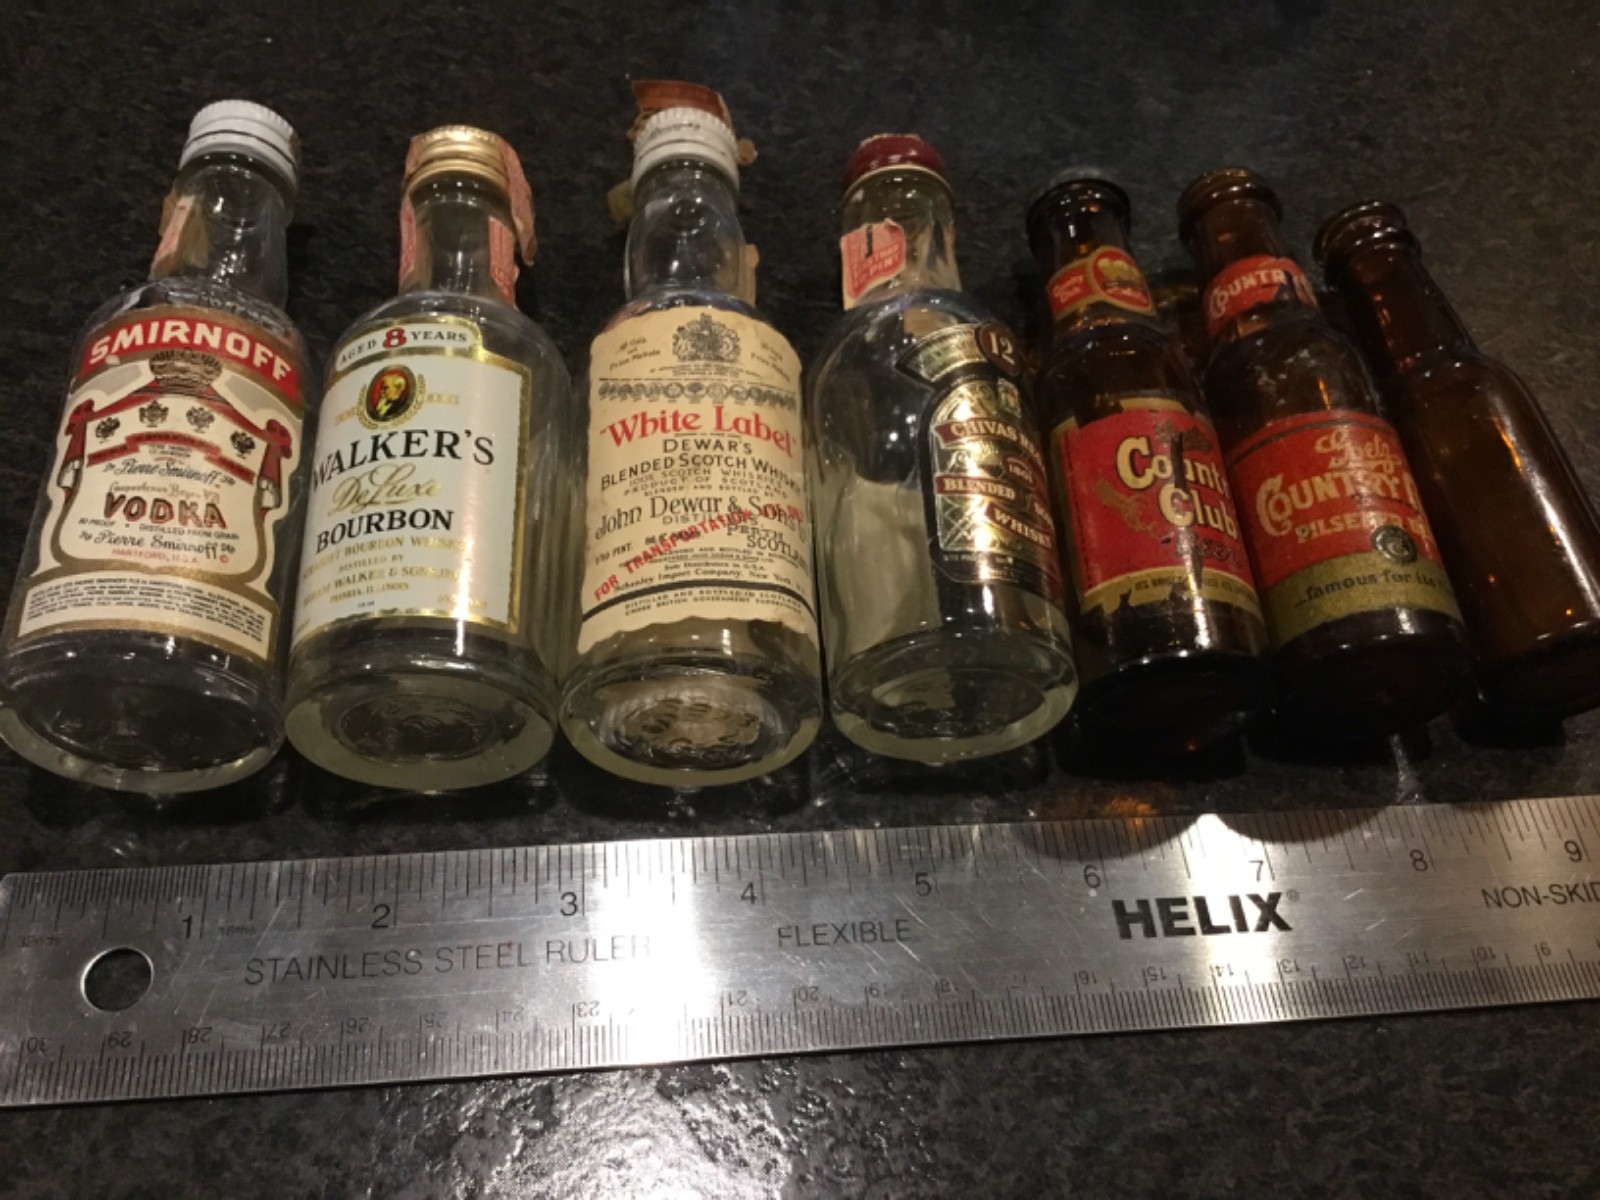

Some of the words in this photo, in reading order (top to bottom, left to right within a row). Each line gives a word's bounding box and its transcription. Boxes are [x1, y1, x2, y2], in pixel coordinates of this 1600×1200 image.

[1209, 268, 1287, 318] COUNTR
[88, 320, 291, 381] SMIRNOFF
[339, 338, 377, 364] AGED
[383, 326, 407, 349] 8
[411, 329, 467, 342] YEARS
[989, 332, 1016, 366] 12
[950, 420, 1018, 442] CHIVAS
[663, 438, 753, 454] DEWAR'S
[312, 428, 495, 494] WALKER'S
[601, 456, 675, 491] BLENDED
[678, 453, 747, 469] SCOTCH
[943, 478, 1016, 501] BLENDED
[103, 492, 227, 529] VODKA
[595, 506, 643, 540] John
[650, 496, 723, 519] Dewar
[728, 495, 742, 513] &
[1159, 483, 1239, 539] Club
[315, 508, 454, 553] BOURBON
[94, 528, 145, 548] Pierre
[150, 534, 219, 560] Smirnoff
[593, 574, 619, 602] FOR
[1384, 568, 1411, 583] for
[182, 914, 194, 939] 1
[371, 903, 391, 929] 2
[559, 892, 579, 917] 3
[740, 882, 758, 905] 4
[914, 872, 932, 897] 5
[1083, 864, 1101, 889] 6
[1249, 860, 1264, 883] 7
[1409, 849, 1428, 872] 8
[1564, 840, 1583, 863] 9
[1111, 891, 1293, 940] HELIX
[777, 919, 912, 949] FLEXIBLE
[243, 949, 424, 986] STAINLESS
[434, 941, 532, 974] STEEL
[546, 935, 652, 965] RULER
[1281, 958, 1302, 973] 13
[1347, 956, 1366, 970] 12
[1478, 946, 1496, 962] 10
[1078, 970, 1098, 986] 16
[1146, 966, 1167, 981] 15
[727, 990, 749, 1006] 21
[799, 985, 820, 1003] 20
[577, 1001, 600, 1018] 23
[187, 1026, 213, 1044] 28
[266, 1020, 292, 1041] 27
[346, 1016, 370, 1034] 26
[106, 1030, 132, 1048] 29
